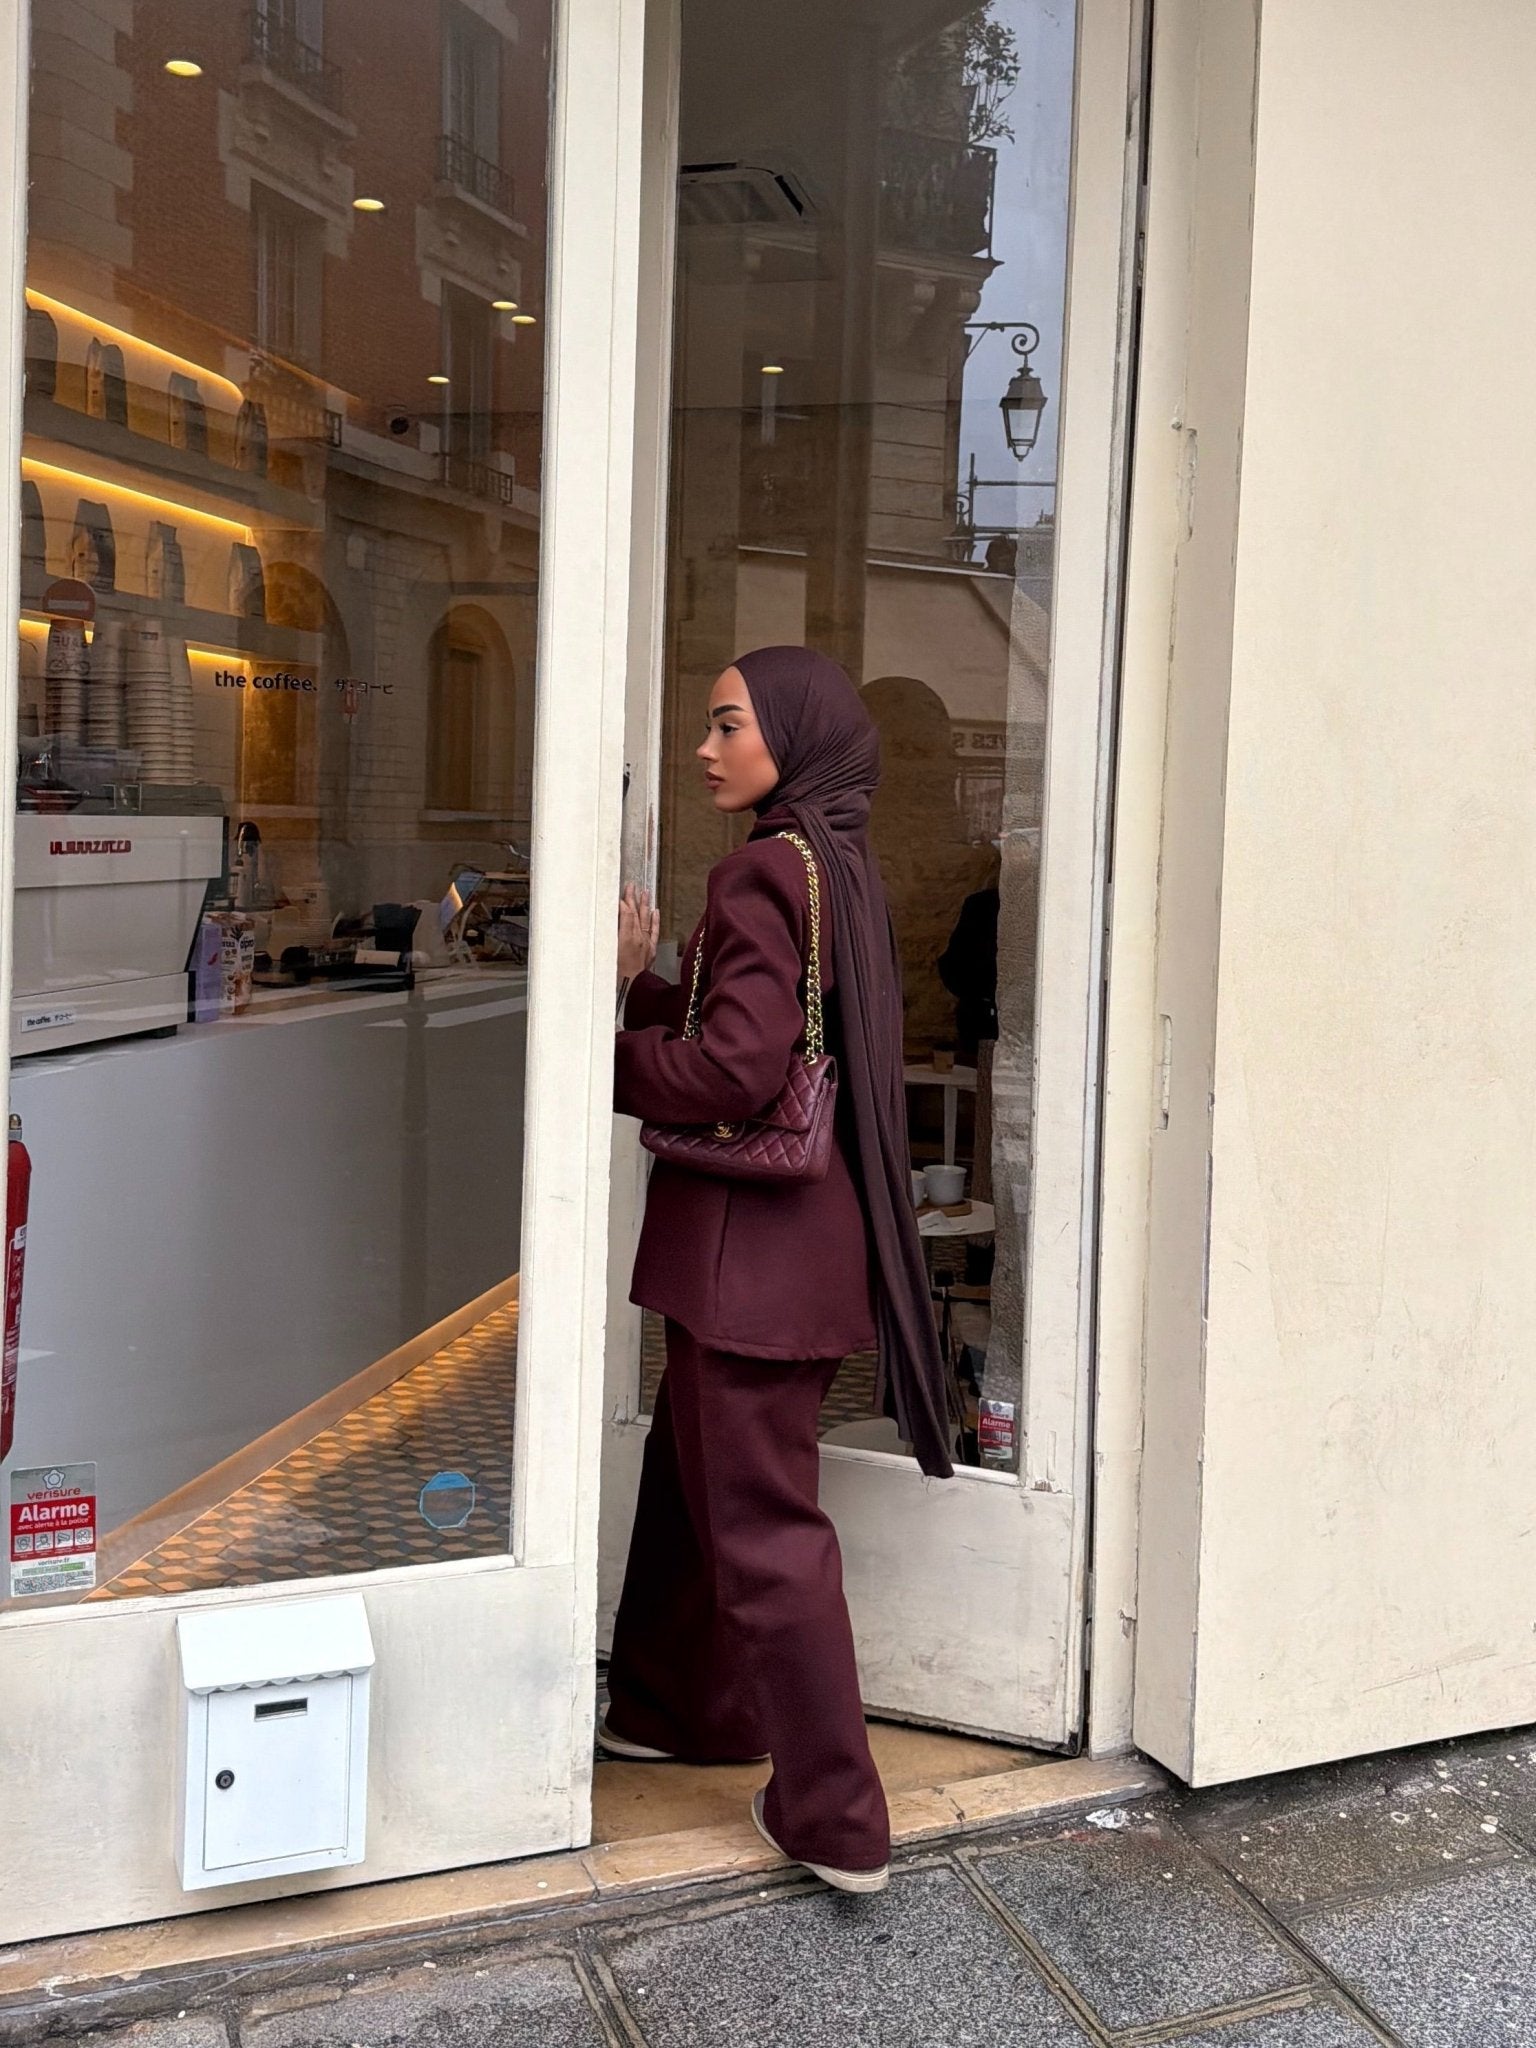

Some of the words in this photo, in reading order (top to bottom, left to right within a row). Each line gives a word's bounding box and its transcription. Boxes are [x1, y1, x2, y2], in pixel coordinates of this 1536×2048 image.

[215, 671, 247, 688] the
[252, 673, 317, 692] coffee.
[982, 1417, 1011, 1429] Alarme
[27, 1487, 81, 1500] verisure
[19, 1502, 89, 1523] Alarme
